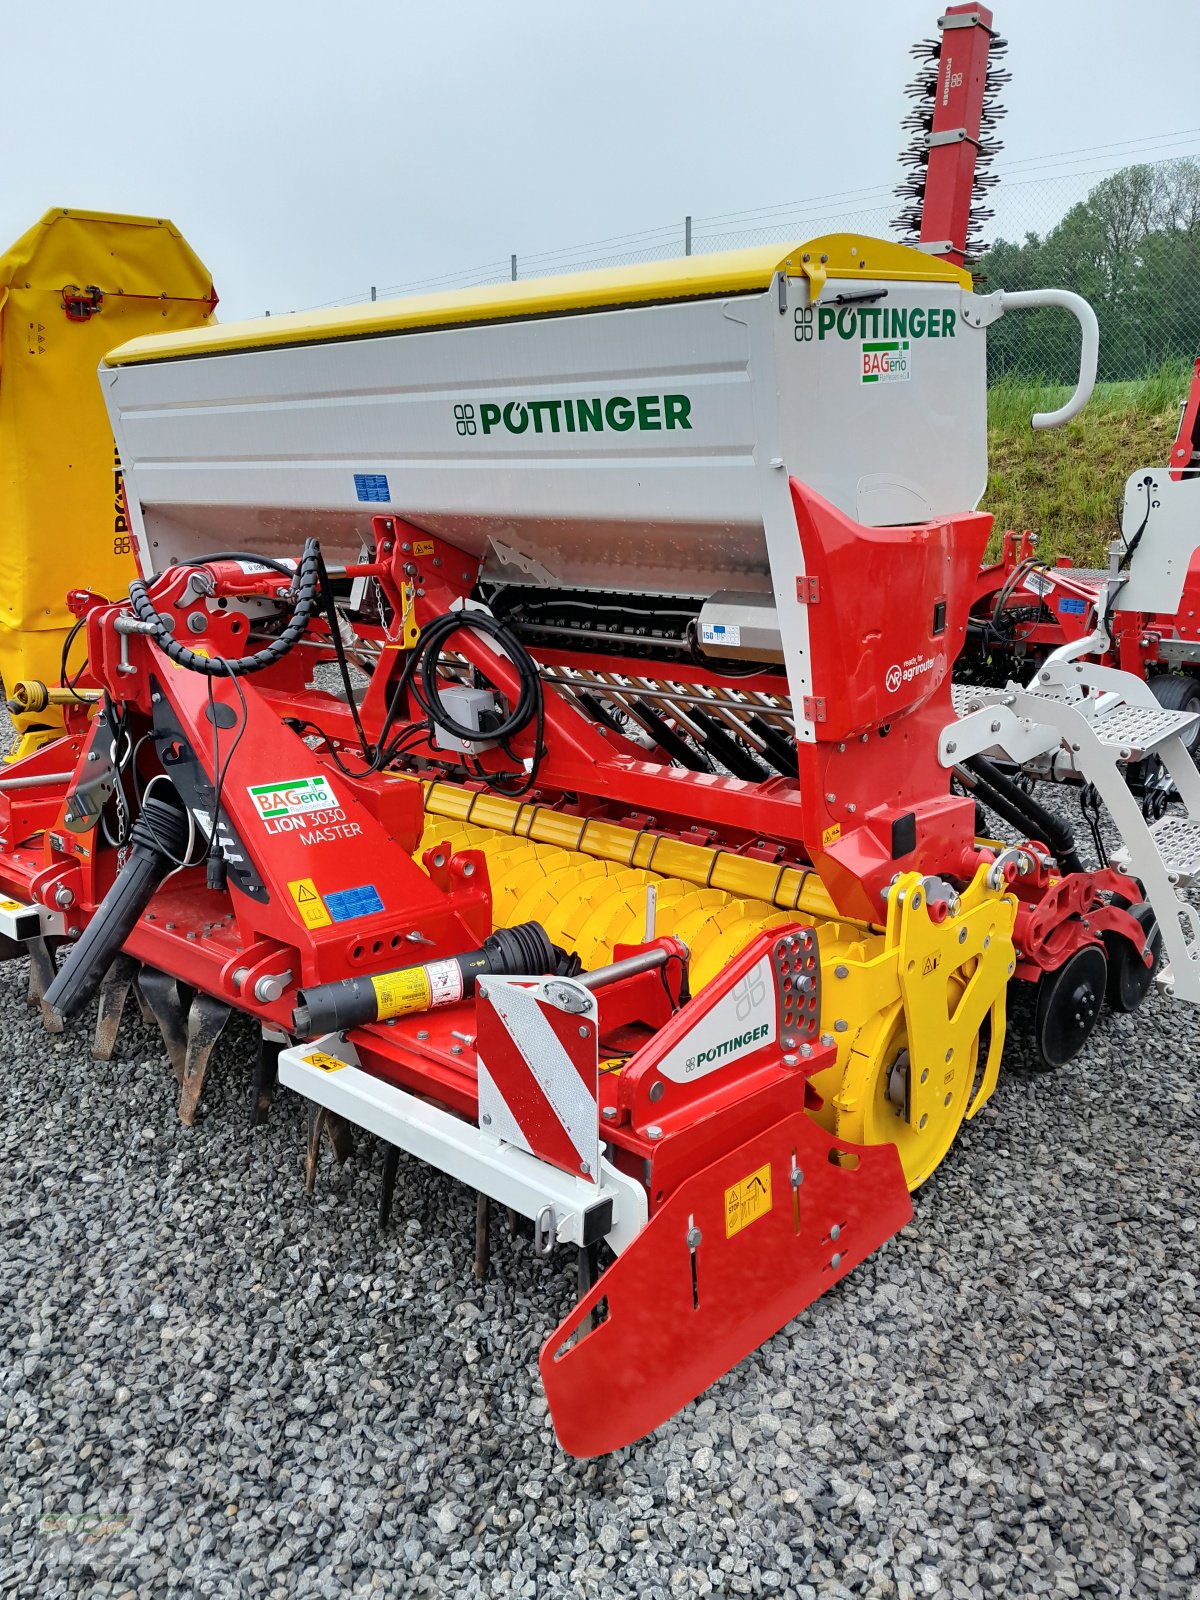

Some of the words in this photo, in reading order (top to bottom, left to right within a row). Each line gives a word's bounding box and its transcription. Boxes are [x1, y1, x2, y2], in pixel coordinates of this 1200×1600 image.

[818, 307, 957, 341] PÖTTINGER
[863, 352, 907, 375] BAGeno
[479, 394, 693, 435] PÖTTINGER
[902, 657, 936, 682] agrirouter
[256, 789, 328, 812] BAGeno
[263, 815, 307, 835] LION
[306, 808, 347, 827] 3030
[299, 822, 364, 846] MASTER
[728, 1201, 740, 1214] STOP
